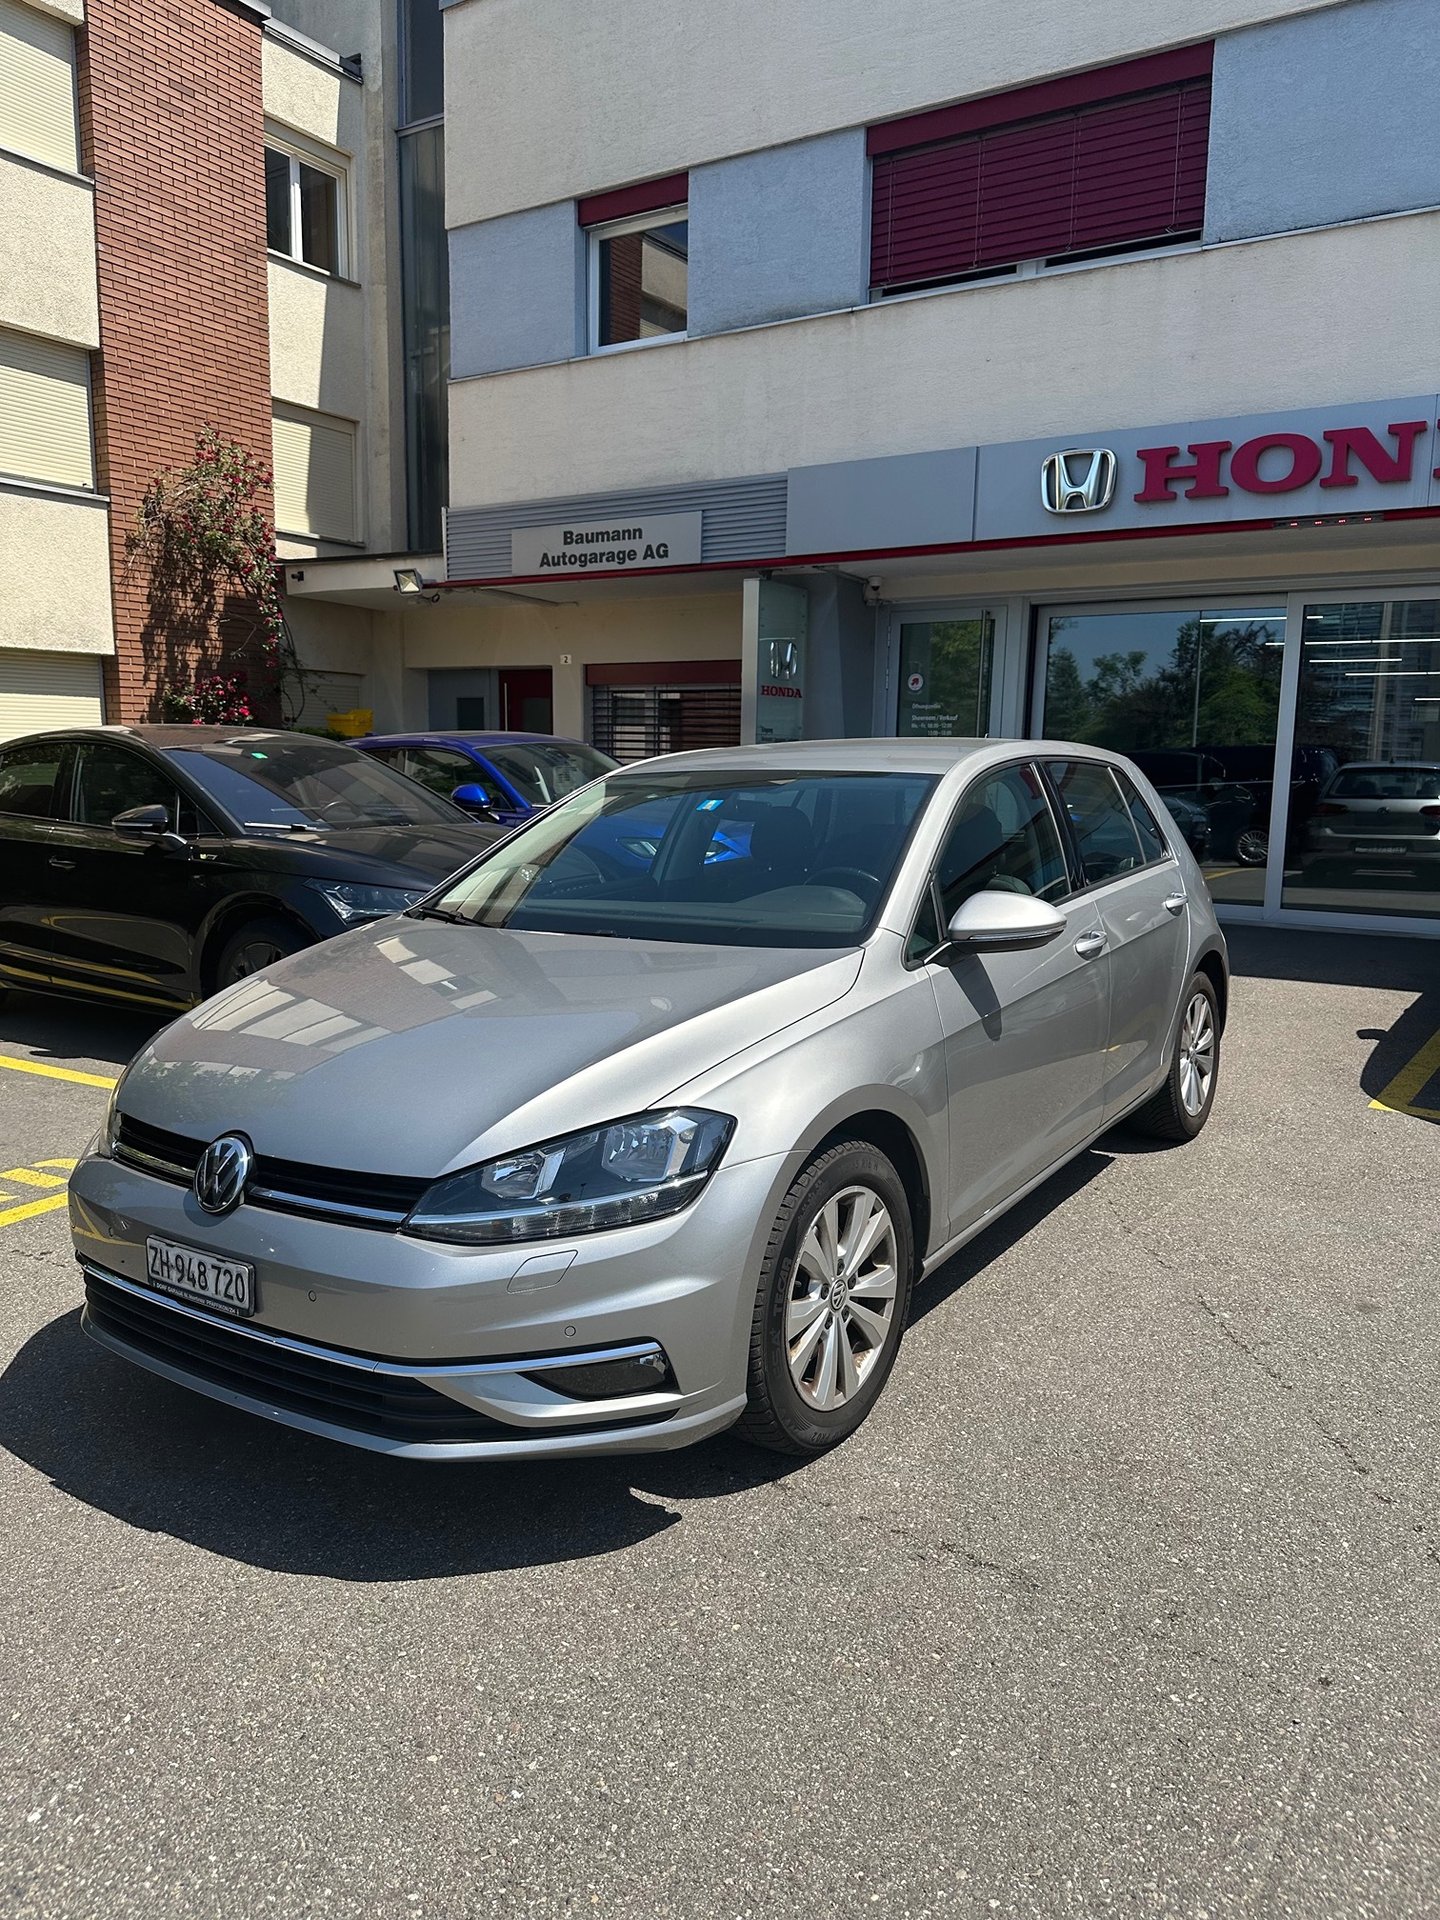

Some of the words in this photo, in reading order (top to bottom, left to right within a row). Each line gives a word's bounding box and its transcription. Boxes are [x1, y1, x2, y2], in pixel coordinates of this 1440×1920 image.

[1133, 420, 1440, 504] HON
[563, 528, 643, 546] Baumann
[539, 548, 638, 568] Autogarage
[642, 542, 669, 561] AG
[563, 655, 569, 664] 2
[760, 685, 803, 699] HONDA
[211, 1264, 246, 1303] 720
